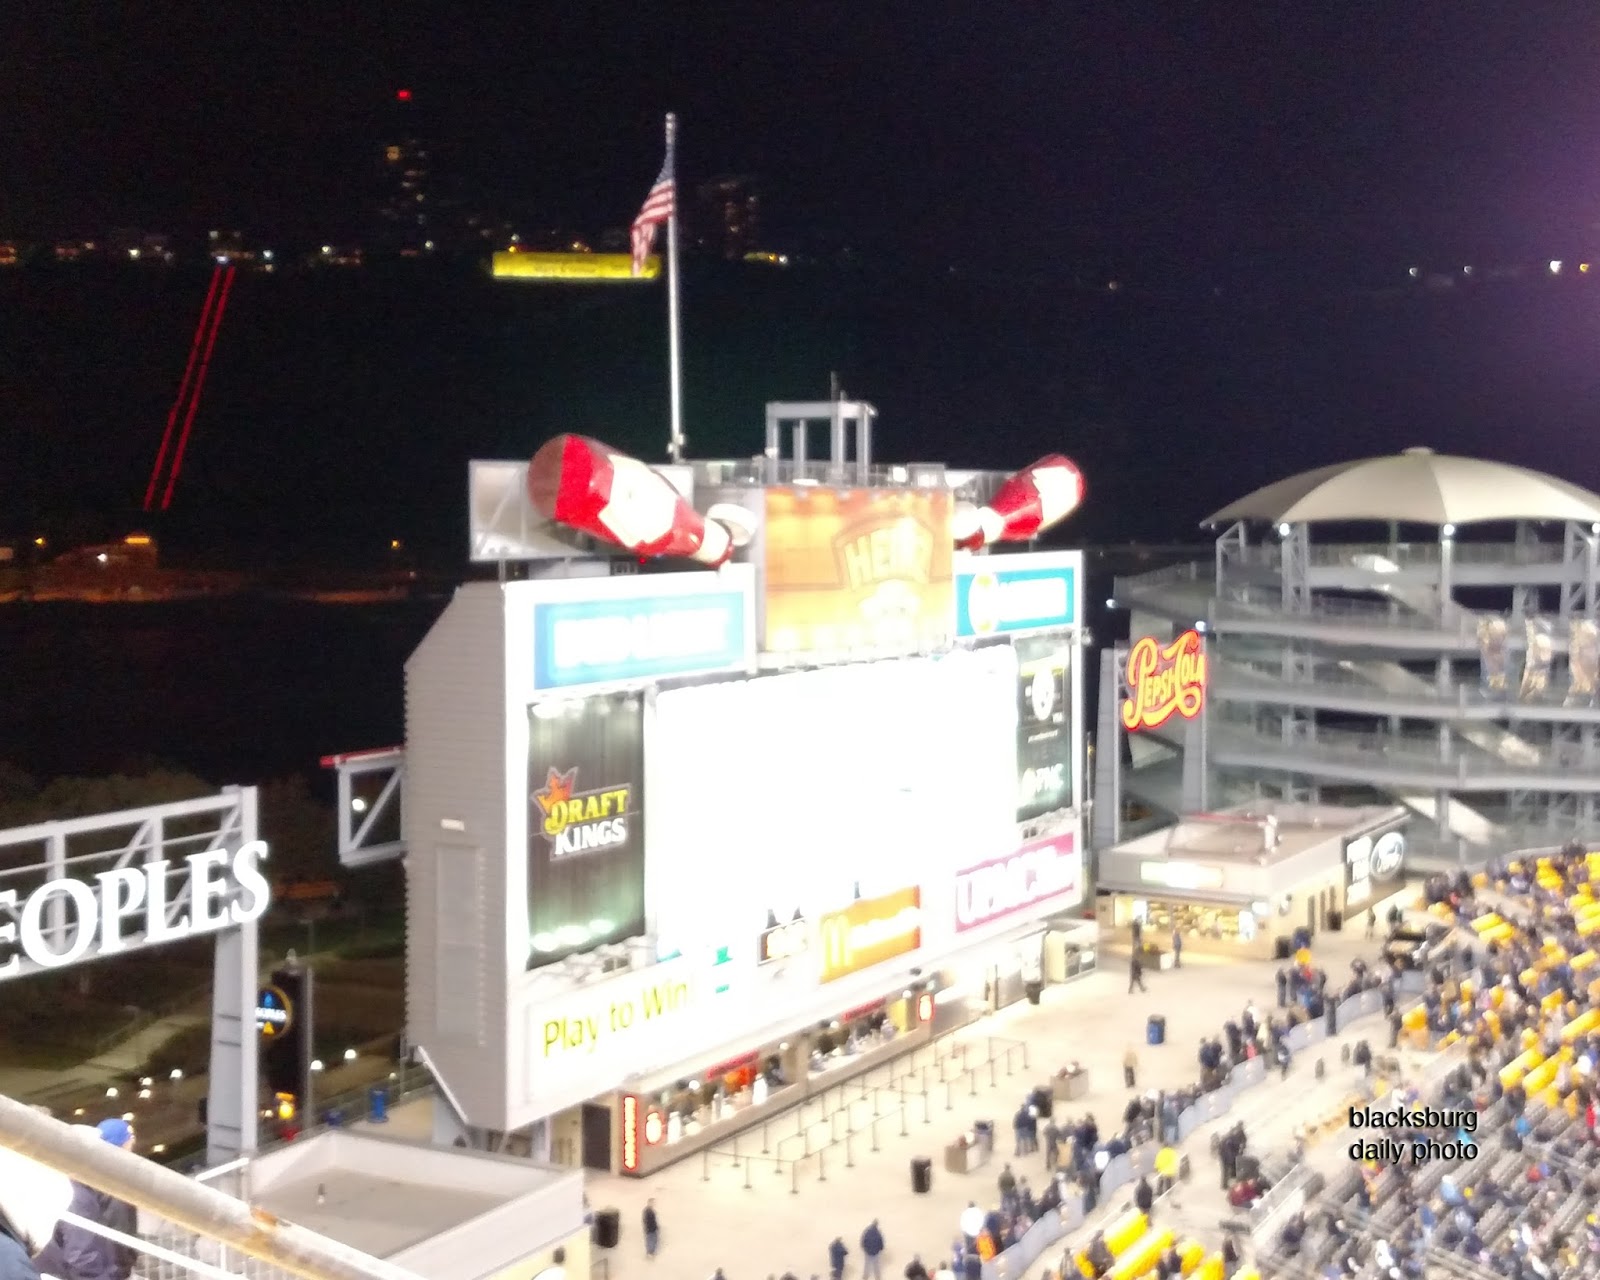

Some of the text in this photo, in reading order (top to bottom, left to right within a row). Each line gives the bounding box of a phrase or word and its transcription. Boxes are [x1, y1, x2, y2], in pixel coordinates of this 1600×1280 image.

[544, 789, 628, 835] DRAFT
[554, 817, 626, 855] KINGS
[543, 1014, 598, 1056] Play
[609, 1000, 634, 1032] to
